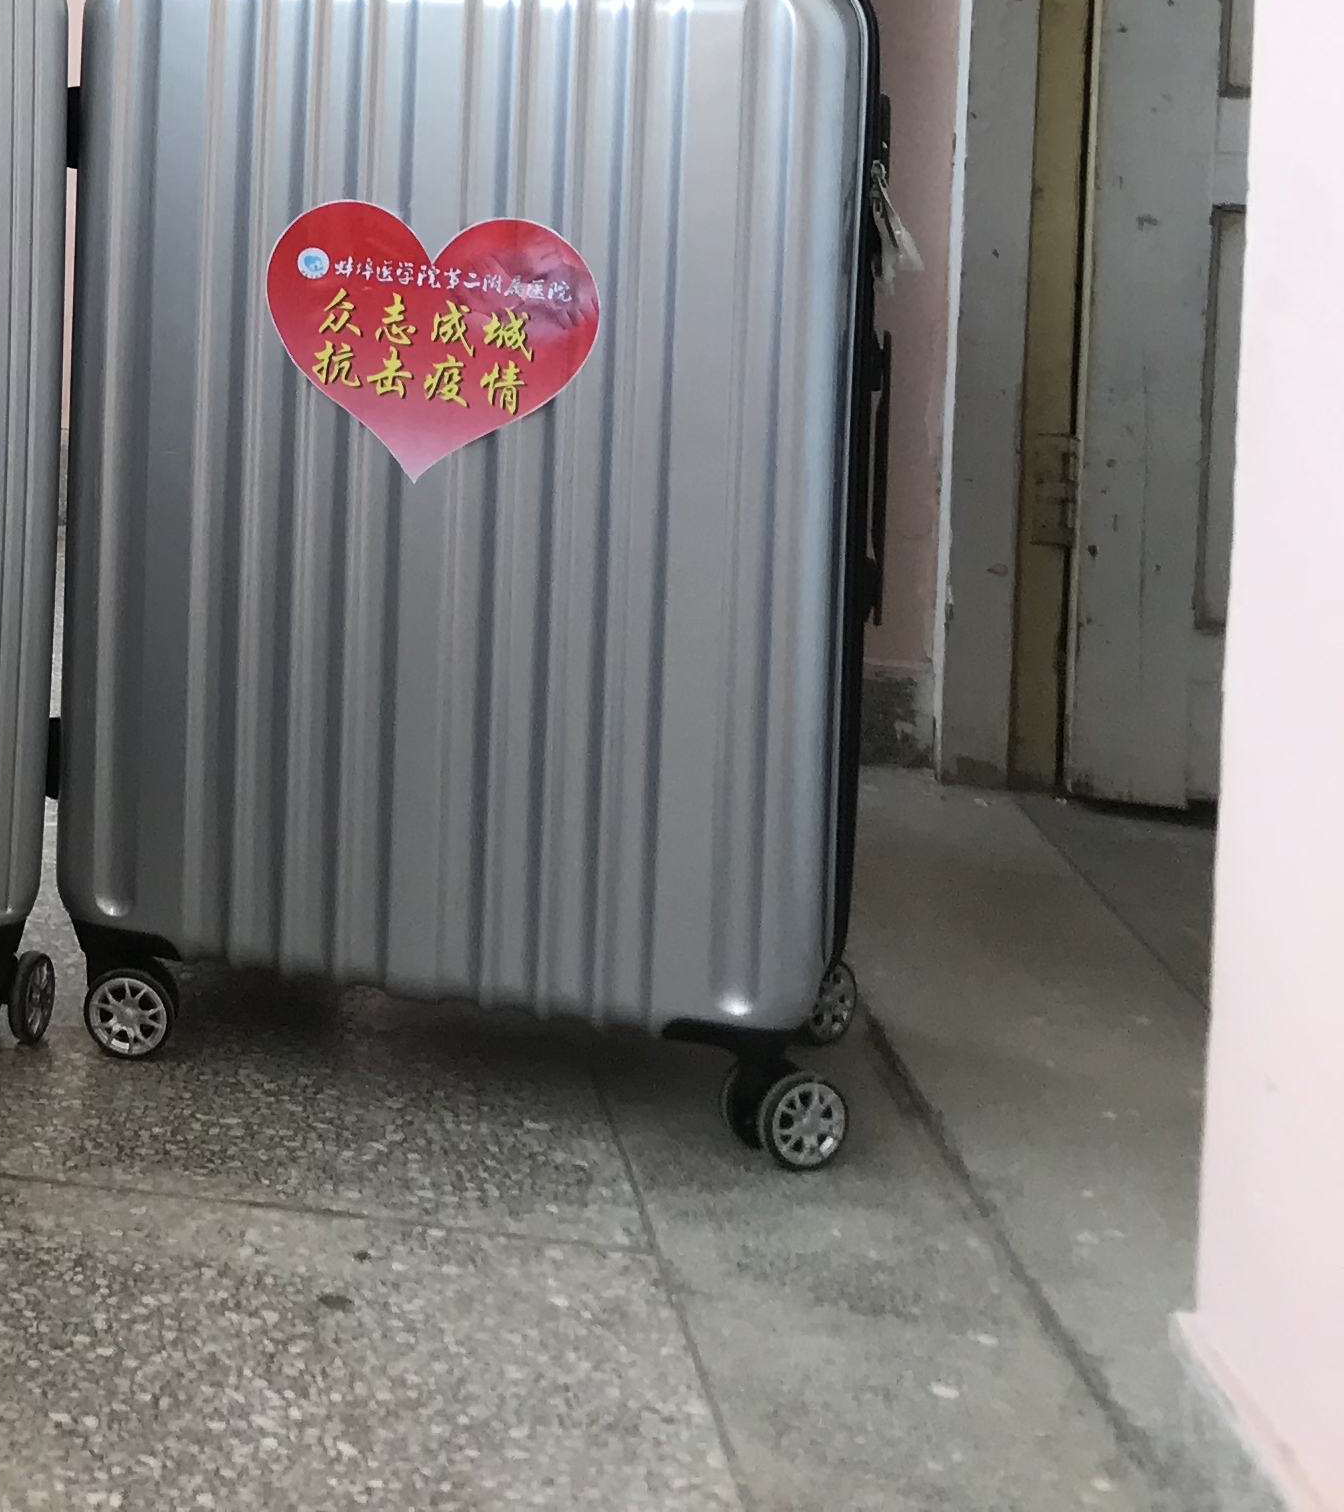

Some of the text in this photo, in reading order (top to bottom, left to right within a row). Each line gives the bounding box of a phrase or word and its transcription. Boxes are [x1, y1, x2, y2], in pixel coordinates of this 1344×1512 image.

[318, 288, 534, 361] 众志成城
[312, 340, 526, 414] 抗击疫情
